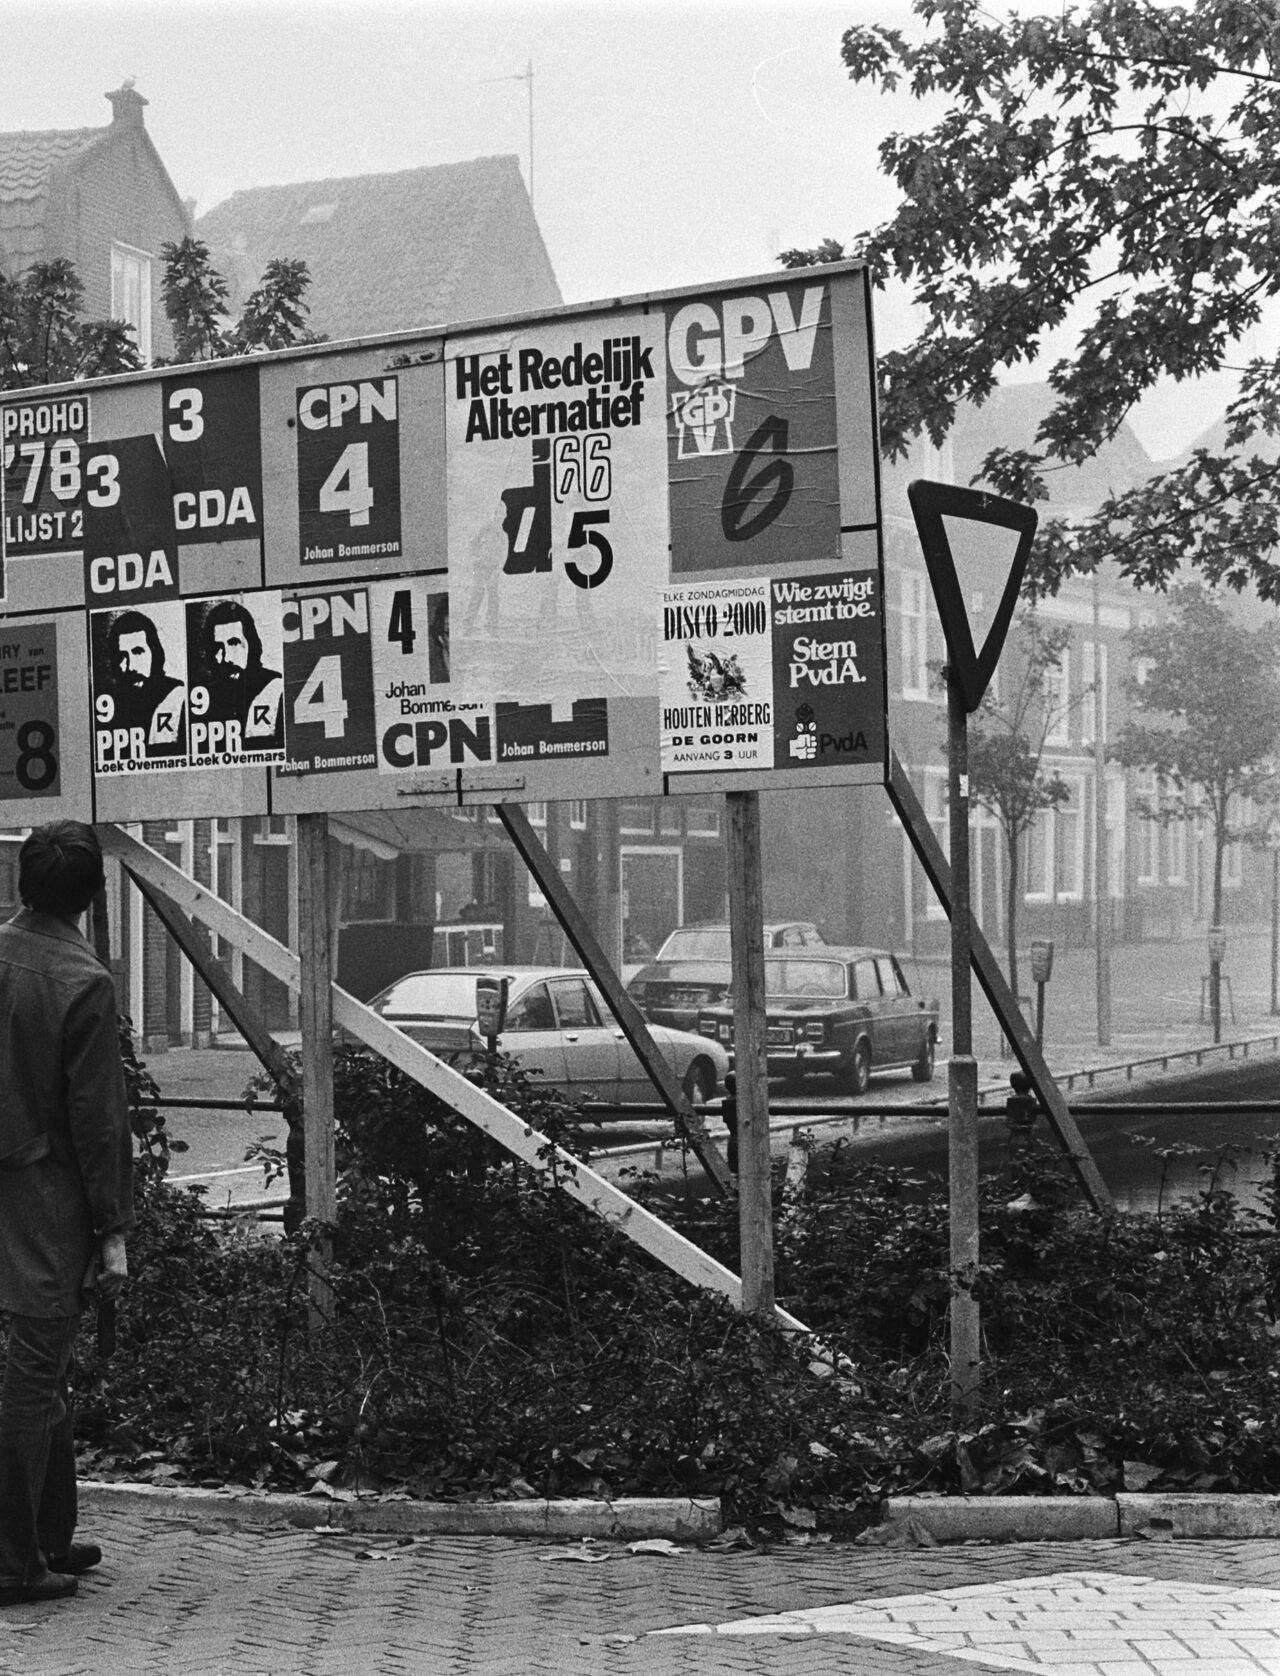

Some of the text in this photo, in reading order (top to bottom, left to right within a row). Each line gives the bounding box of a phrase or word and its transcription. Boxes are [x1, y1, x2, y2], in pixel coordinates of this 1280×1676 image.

[669, 286, 825, 387] GPV
[456, 336, 656, 400] Het Redelijk
[4, 402, 84, 438] PROHO
[169, 387, 205, 443] 3
[298, 379, 398, 431] CPN
[465, 381, 645, 443] Alternatief
[86, 454, 121, 508] 3
[319, 441, 374, 527] 4
[721, 414, 794, 542] 6
[173, 486, 257, 530] CDA
[5, 510, 84, 544] LIJST 2
[304, 541, 400, 561] Johan Bommerson
[564, 509, 614, 590] 5
[90, 549, 174, 594] CDA
[664, 587, 765, 602] ELKE ZONDAGMIDDAG
[773, 577, 874, 604] Wie zwijgt
[283, 592, 369, 643] CPN
[388, 590, 416, 654] 4
[664, 601, 767, 641] DISCO 2000
[775, 601, 876, 625] stemt toe.
[793, 637, 857, 662] Stem
[385, 681, 426, 698] Johan
[789, 658, 867, 688] PvdA.
[95, 694, 115, 723] 9
[190, 686, 210, 715] 9
[294, 655, 349, 740] 4
[664, 702, 771, 730] HOUTEN HERBERG
[96, 726, 147, 762] PPR
[191, 719, 243, 755] PPR
[382, 716, 492, 768] CPN
[502, 739, 606, 757] Johan Bommerson
[672, 733, 759, 746] DE GOORN
[821, 731, 868, 753] PvdA
[16, 720, 57, 791] 8
[95, 758, 187, 774] Loek Overmars
[189, 750, 285, 767] Loek Overmars
[314, 754, 375, 768] Bommerson
[674, 750, 758, 762] AANVANG 3 UUR
